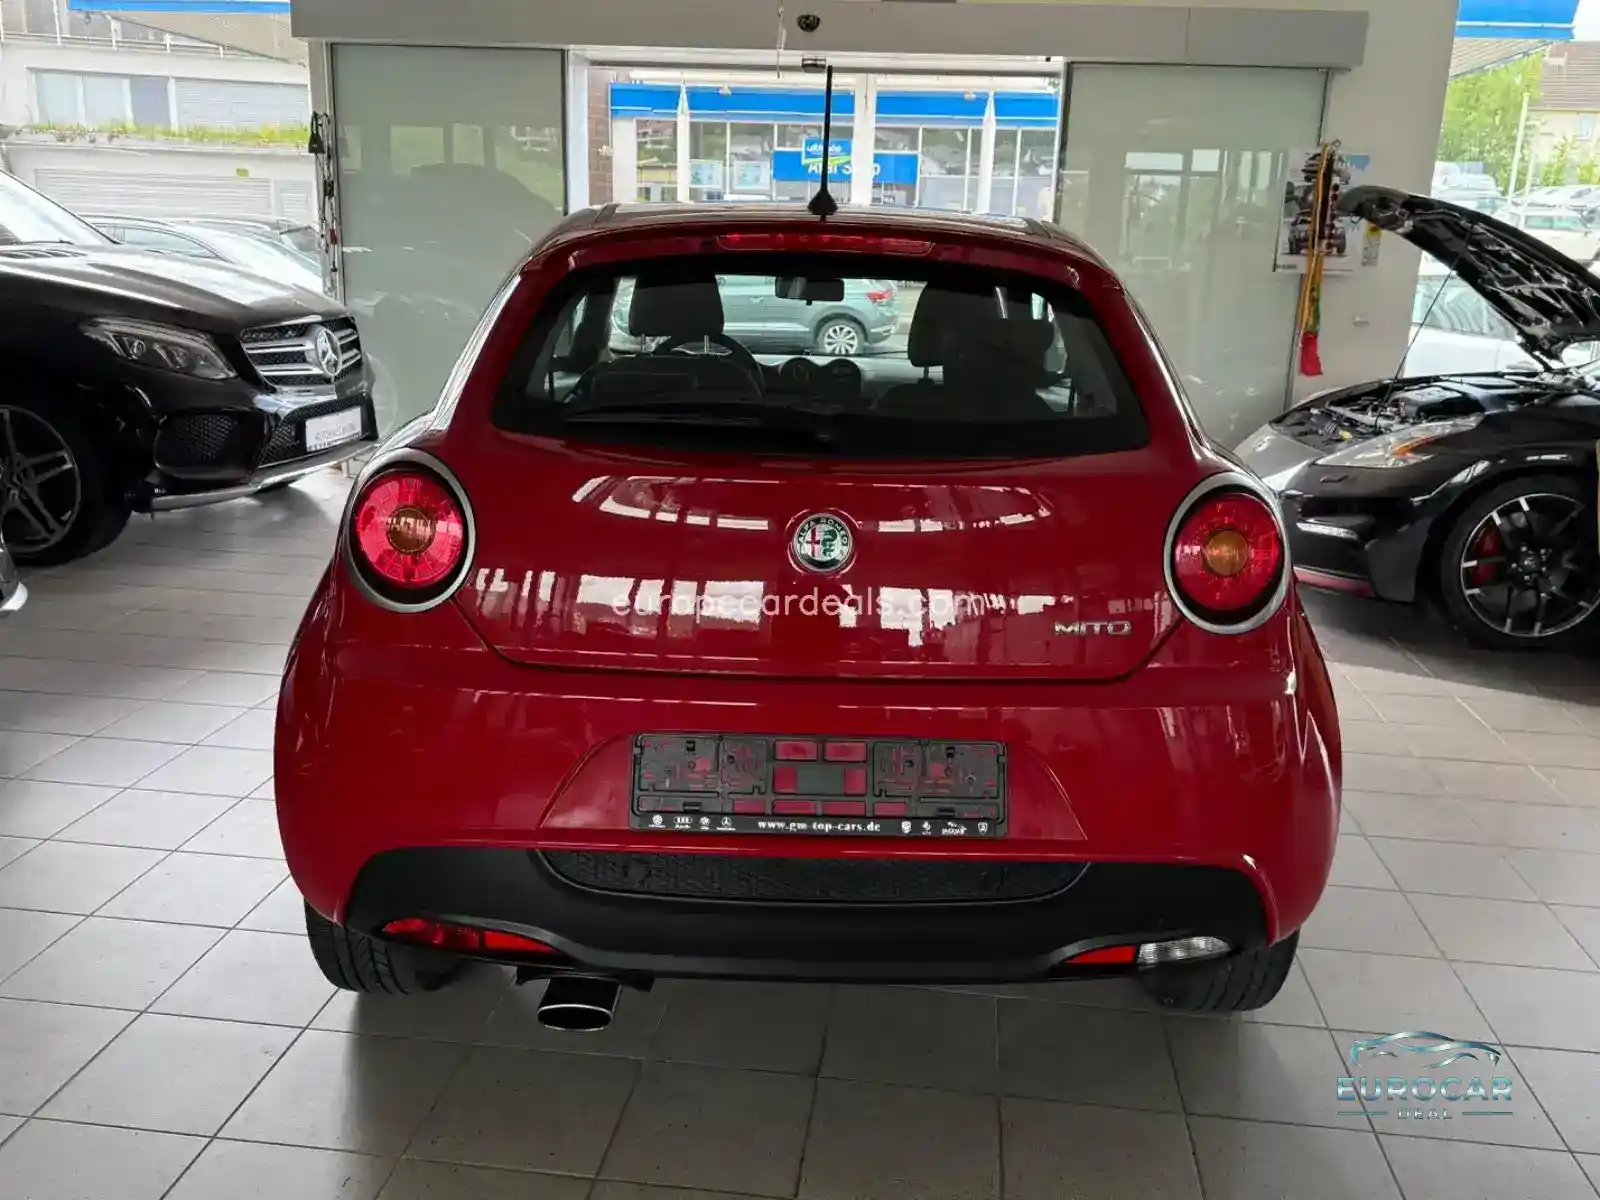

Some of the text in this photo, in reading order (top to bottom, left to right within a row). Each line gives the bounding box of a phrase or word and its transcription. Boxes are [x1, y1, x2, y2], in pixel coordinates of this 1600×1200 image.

[798, 517, 849, 545] ALFA ROMEO
[1054, 621, 1132, 635] MITO
[758, 821, 881, 832] www.gm-top-cars.de
